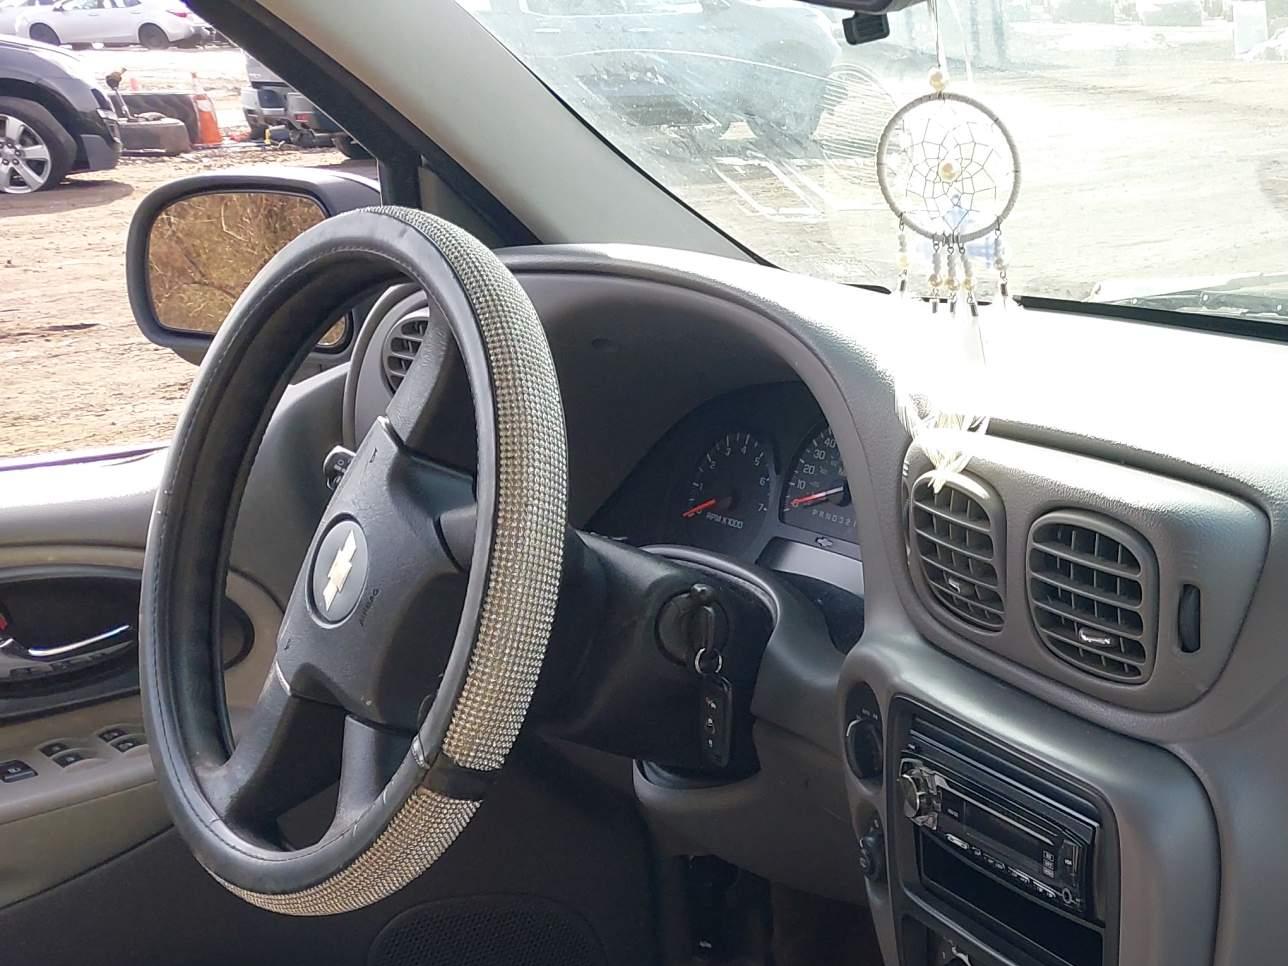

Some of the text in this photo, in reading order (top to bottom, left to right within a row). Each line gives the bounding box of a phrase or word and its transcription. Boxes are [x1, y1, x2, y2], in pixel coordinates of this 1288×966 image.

[813, 448, 826, 460] 30
[802, 463, 816, 475] 20
[796, 480, 806, 490] 10
